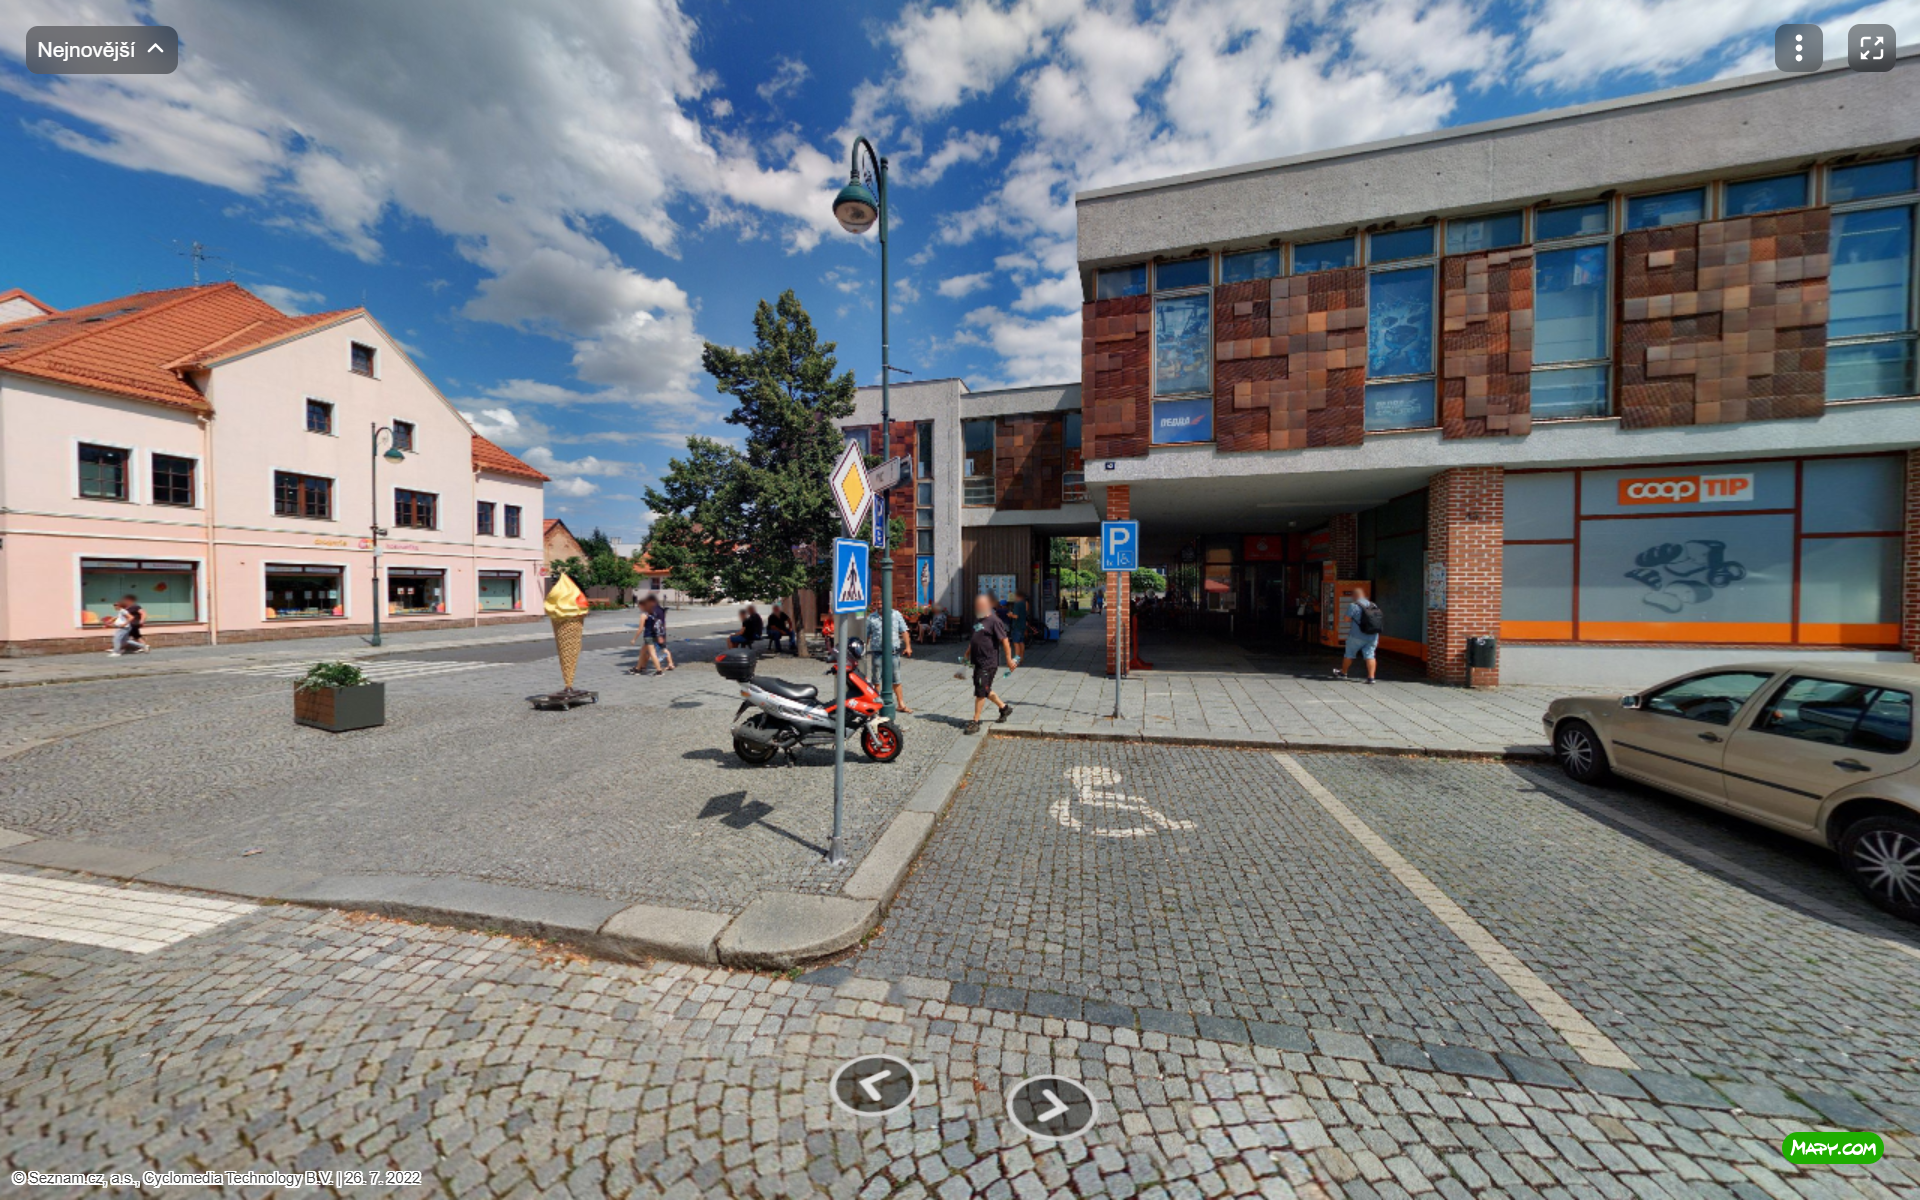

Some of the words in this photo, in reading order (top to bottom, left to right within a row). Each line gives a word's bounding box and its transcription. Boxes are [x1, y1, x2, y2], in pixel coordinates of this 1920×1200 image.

[1627, 481, 1696, 501] coop
[1703, 478, 1750, 497] TIP
[1109, 527, 1130, 555] P
